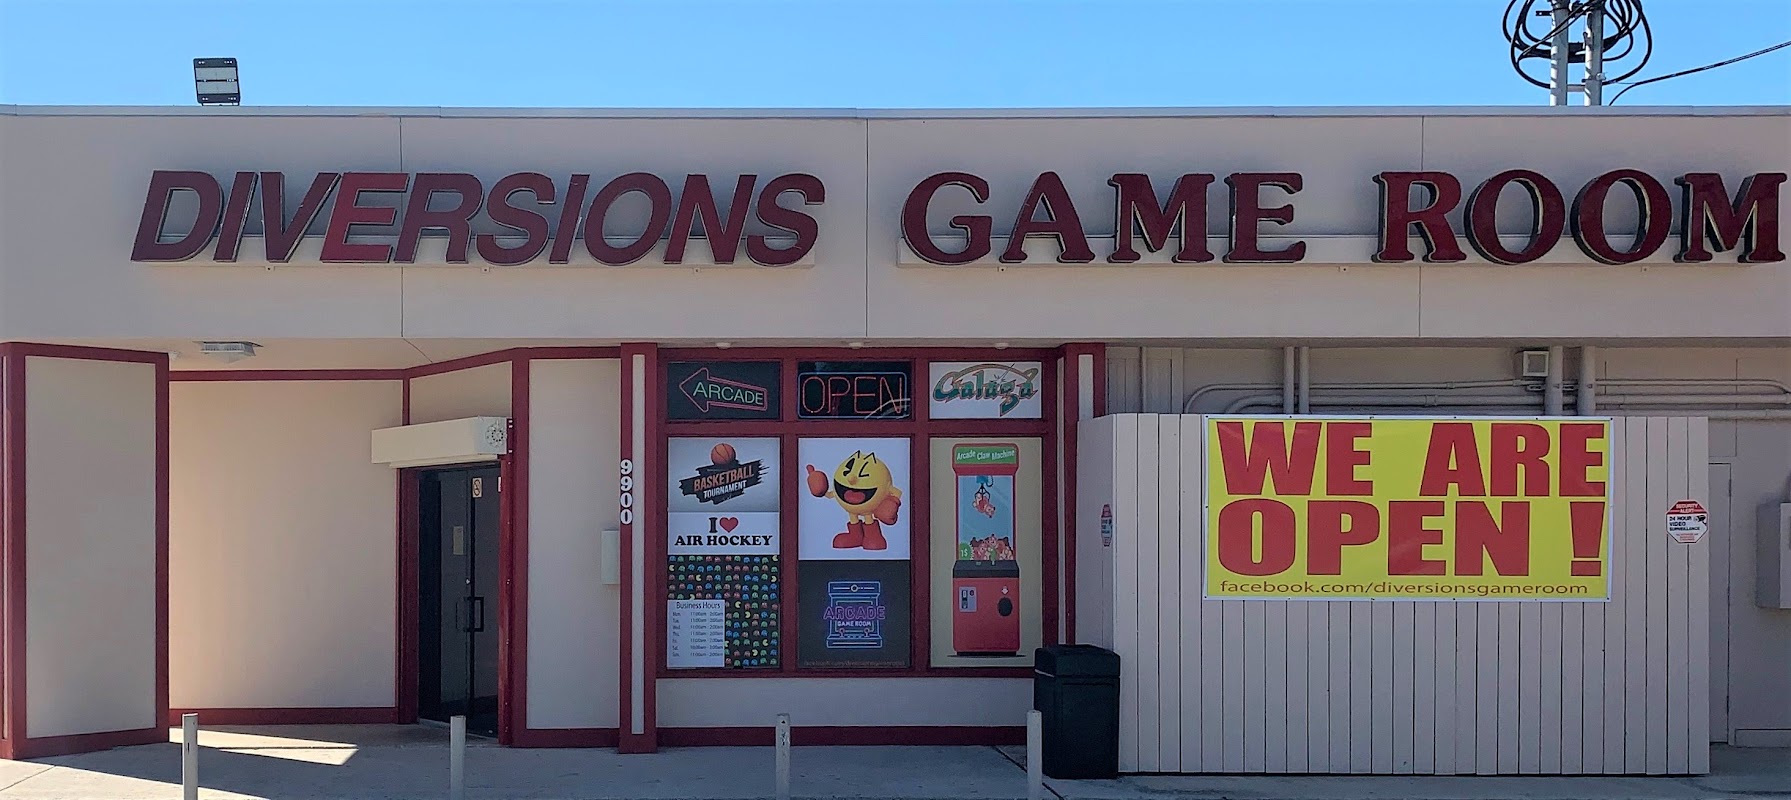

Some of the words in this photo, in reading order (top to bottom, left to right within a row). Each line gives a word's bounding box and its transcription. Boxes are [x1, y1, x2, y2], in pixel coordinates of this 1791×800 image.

[131, 170, 826, 266] DIVERSIONS
[900, 170, 1306, 264] GAME
[1372, 168, 1787, 265] ROOM
[693, 382, 764, 406] ARCADE
[802, 376, 903, 414] OPEN
[957, 449, 976, 461] Arcade
[977, 452, 991, 461] Claw
[991, 449, 1015, 461] Machine
[1216, 421, 1374, 496] WE
[1419, 422, 1606, 497] ARE
[693, 465, 755, 492] BASKETBALL
[703, 480, 748, 499] TOURNAMENT
[619, 459, 634, 525] 9900
[708, 517, 718, 533] I
[1217, 498, 1531, 576] OPEN
[674, 535, 703, 546] AIR
[707, 535, 773, 546] HOCKEY
[1220, 580, 1588, 597] facebook.com/diversionsgameroom
[823, 605, 886, 620] ARCADE
